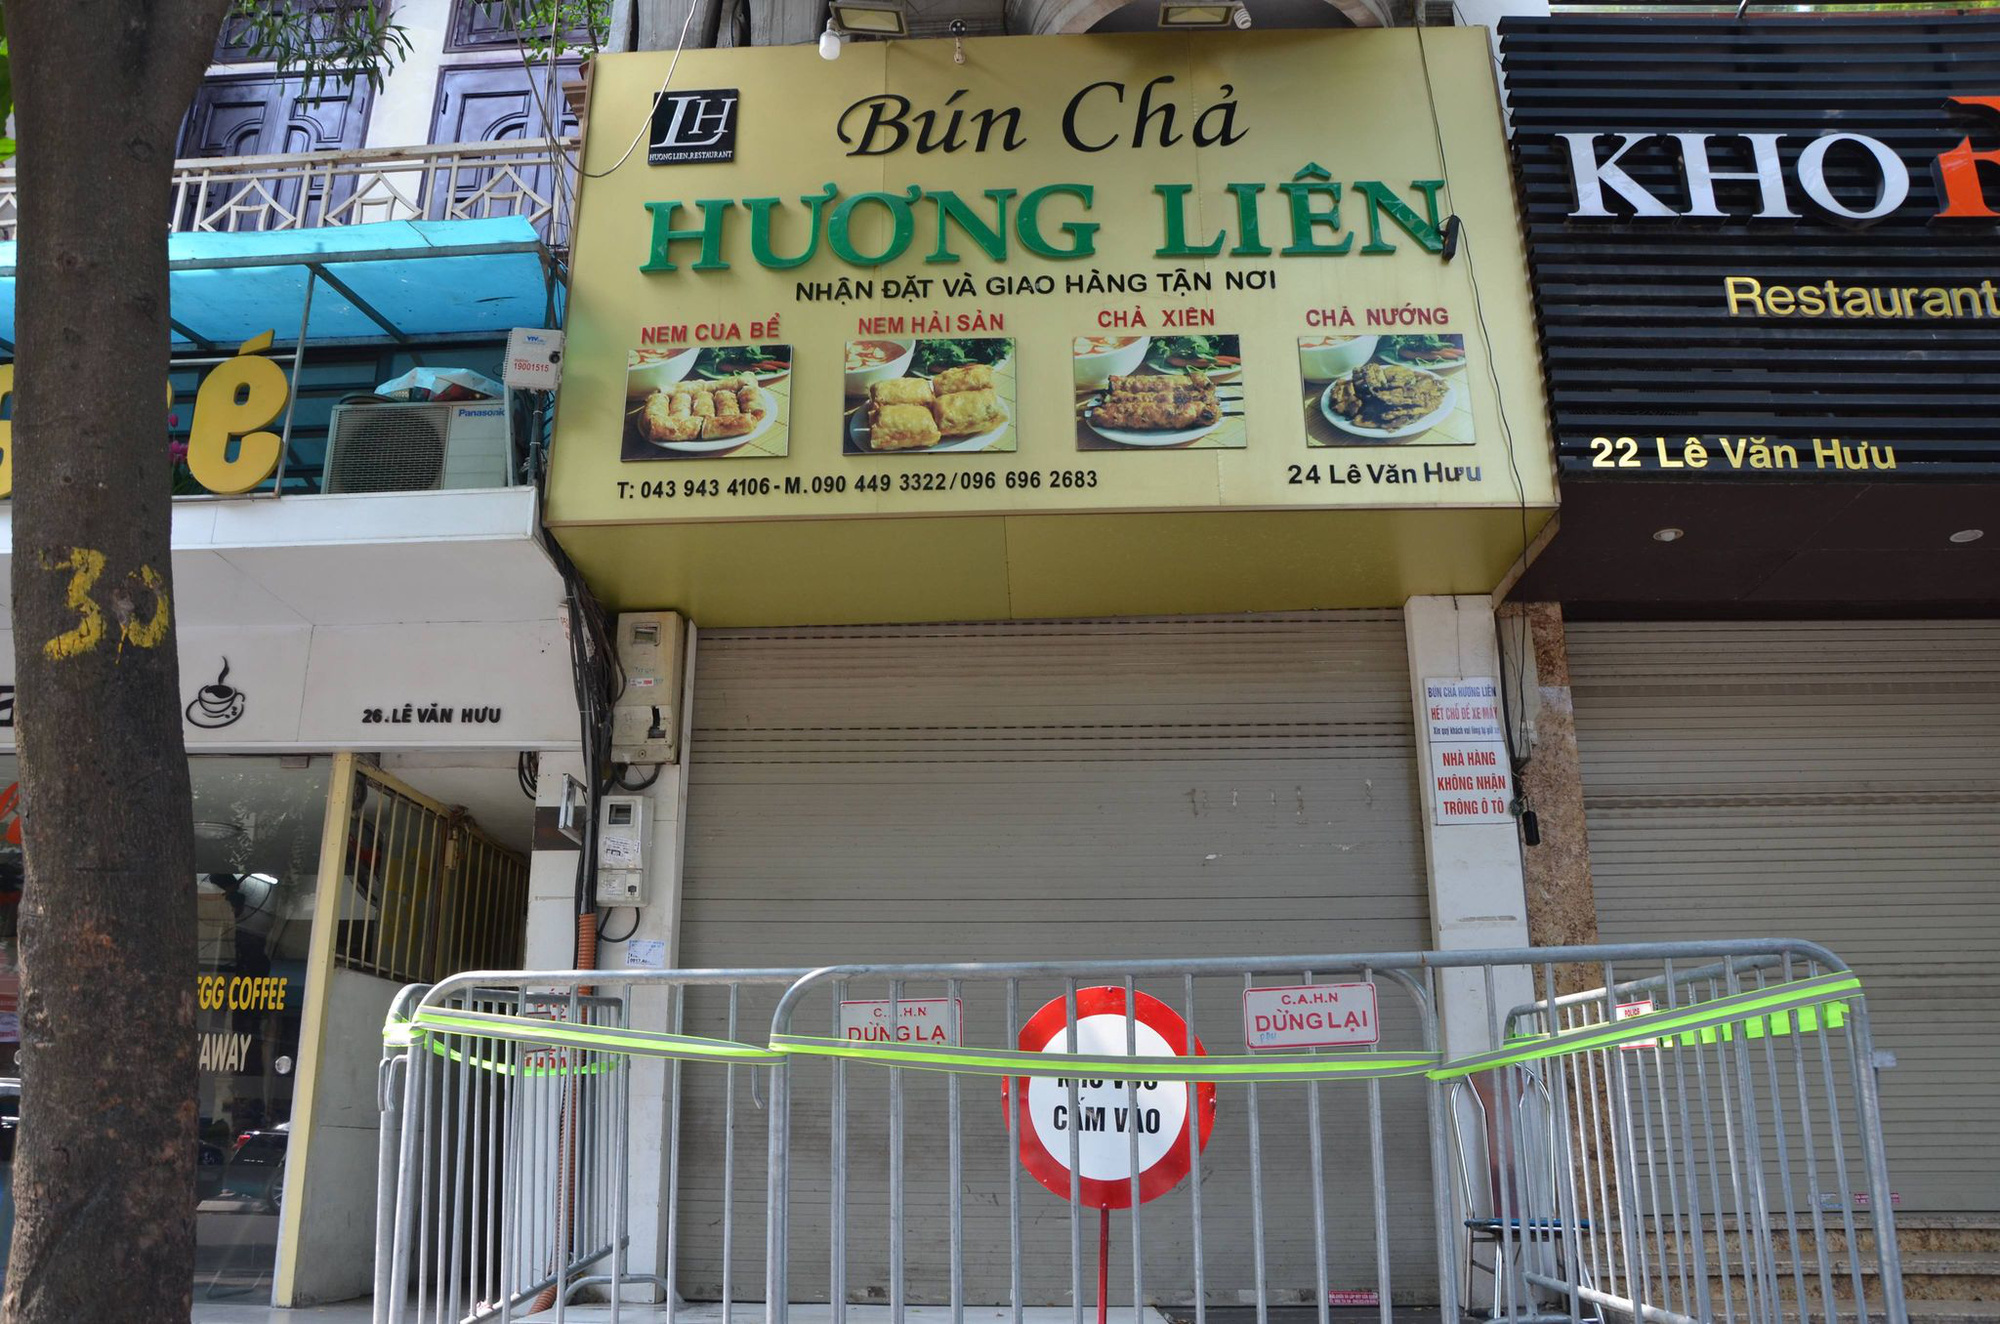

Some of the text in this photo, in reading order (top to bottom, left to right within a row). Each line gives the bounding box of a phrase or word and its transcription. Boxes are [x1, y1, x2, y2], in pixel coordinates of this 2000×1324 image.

[836, 75, 1250, 157] Bún Chả
[639, 161, 1445, 273] HƯƠNG LIÊN
[796, 268, 1276, 305] NHẬN ĐẶT VÀ GIAO HÀNG TẬN NƠI
[1724, 276, 2000, 319] Restaurant
[858, 310, 1004, 335] NEM HẢI SẢN
[1098, 305, 1216, 328] CHẢ XIÊN
[1366, 305, 1450, 326] NƯỚNG
[641, 312, 781, 344] NEM CUA BỂ
[514, 363, 549, 372] 19001515
[459, 407, 505, 417] Panasonic
[1590, 436, 1897, 470] 22 Lê Văn Hưu
[617, 482, 634, 498] T:
[641, 481, 676, 498] 043
[683, 479, 720, 497] 943
[854, 474, 891, 492] 449
[1005, 471, 1041, 489] 696
[1049, 470, 1098, 488] 2683
[1288, 462, 1482, 485] 24 Lê Văn Hưu
[417, 702, 453, 723] VĂN
[461, 706, 501, 723] HƯU
[1442, 749, 1496, 766] NHÀ HÀNG
[1437, 773, 1506, 793] KHÔNG NHẬN
[1443, 797, 1504, 815] TRÔNG Ô TÔ
[228, 976, 287, 1010] COFFEE
[1281, 992, 1338, 1005] C.A.H.N
[873, 1007, 927, 1018] C..H.N
[1255, 1009, 1368, 1032] DỪNG LẠI
[915, 1024, 946, 1045] LẠ
